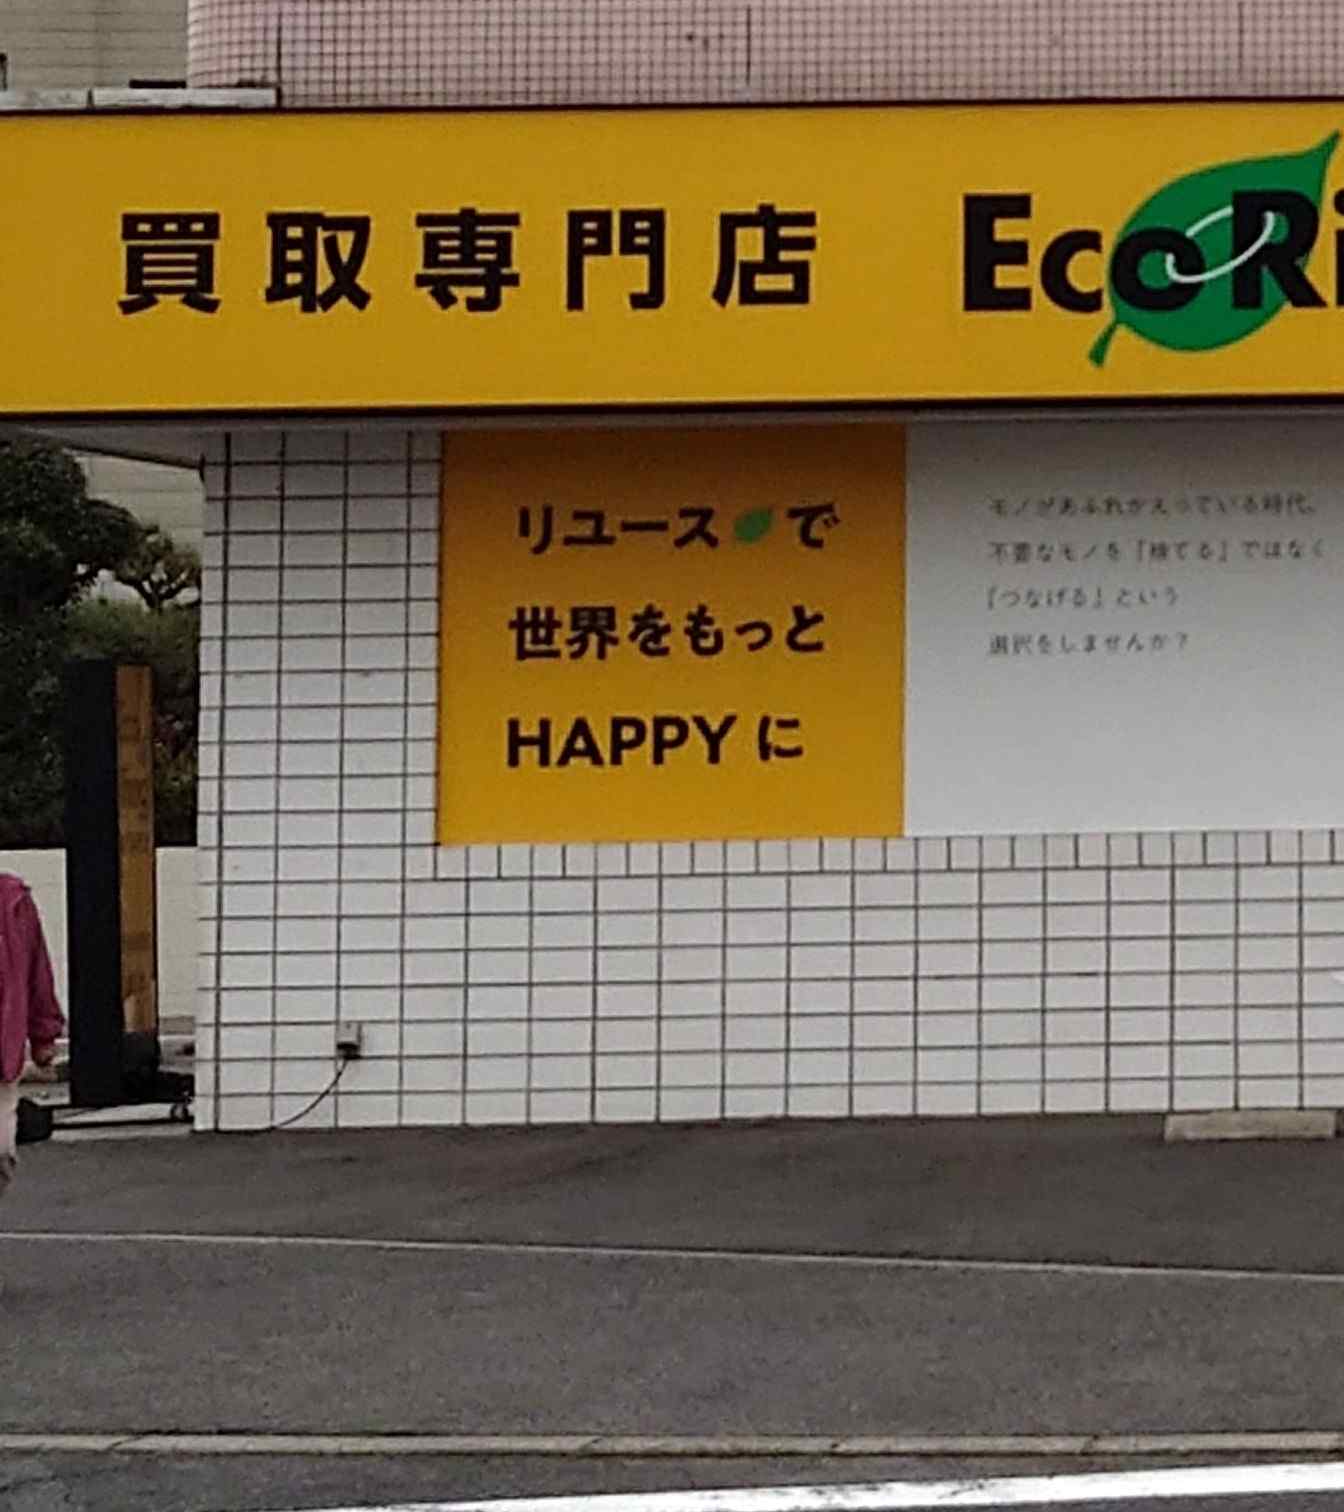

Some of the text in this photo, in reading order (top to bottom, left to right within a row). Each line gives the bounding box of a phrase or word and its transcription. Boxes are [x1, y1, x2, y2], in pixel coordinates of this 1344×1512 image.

[117, 204, 818, 315] 買取専門店
[507, 603, 825, 661] 世界をもっと
